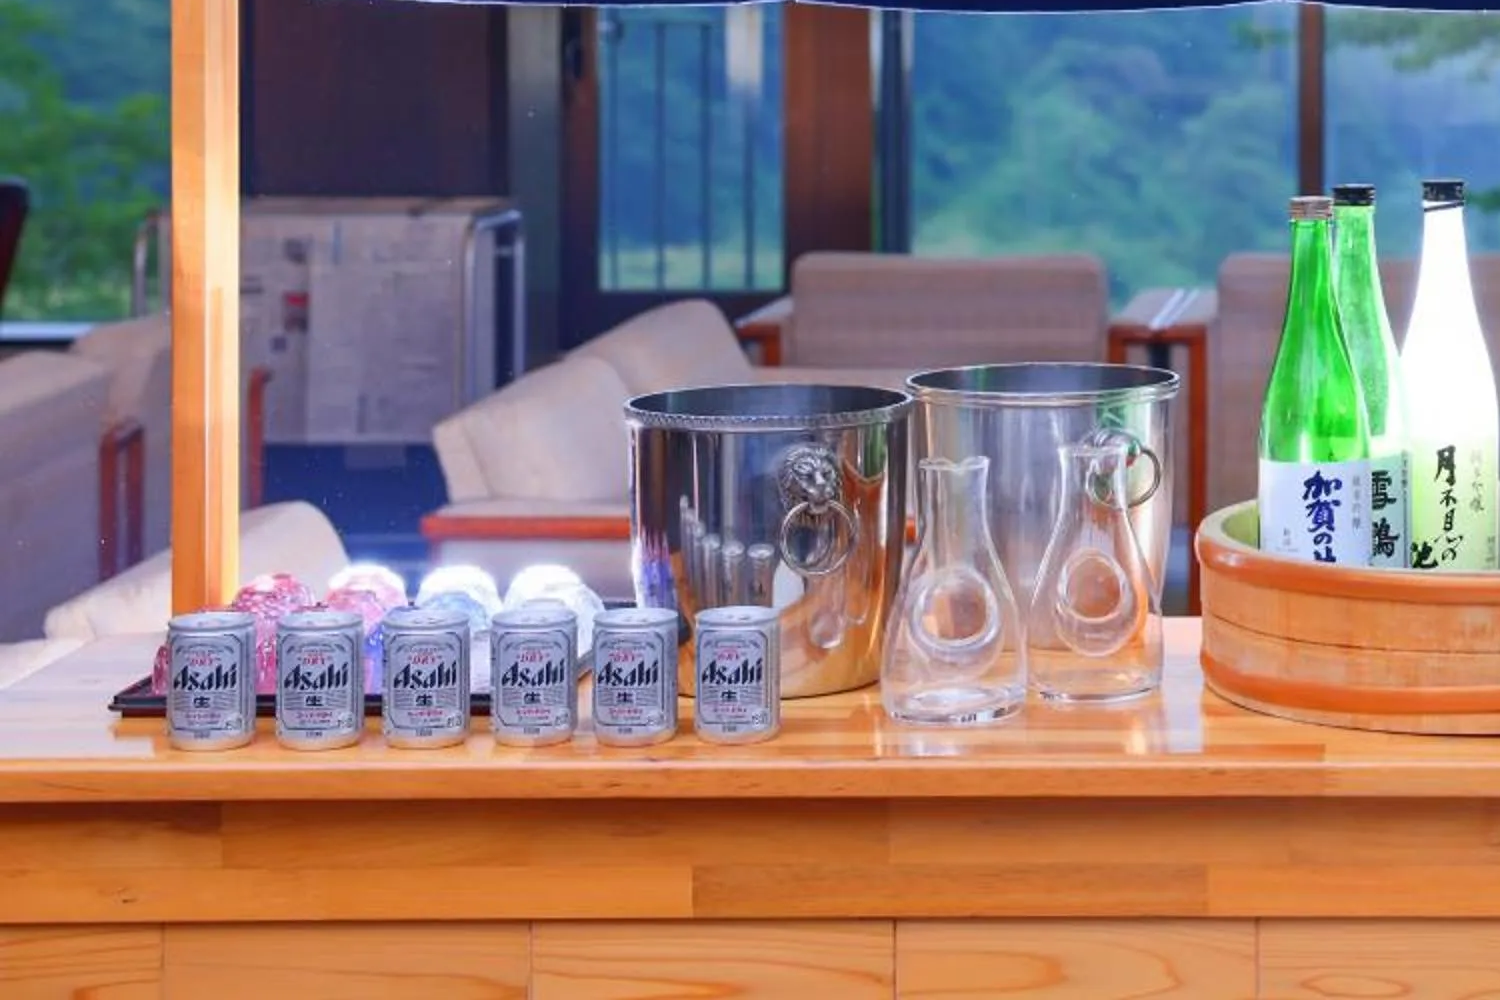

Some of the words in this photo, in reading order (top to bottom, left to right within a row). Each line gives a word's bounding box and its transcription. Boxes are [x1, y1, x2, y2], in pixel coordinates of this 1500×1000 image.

[173, 662, 237, 691] Asahi
[283, 661, 349, 691] Asahi
[393, 659, 457, 690] Asahi
[501, 657, 565, 688] Asahi
[597, 657, 659, 687] Asahi
[701, 656, 763, 686] Asahi
